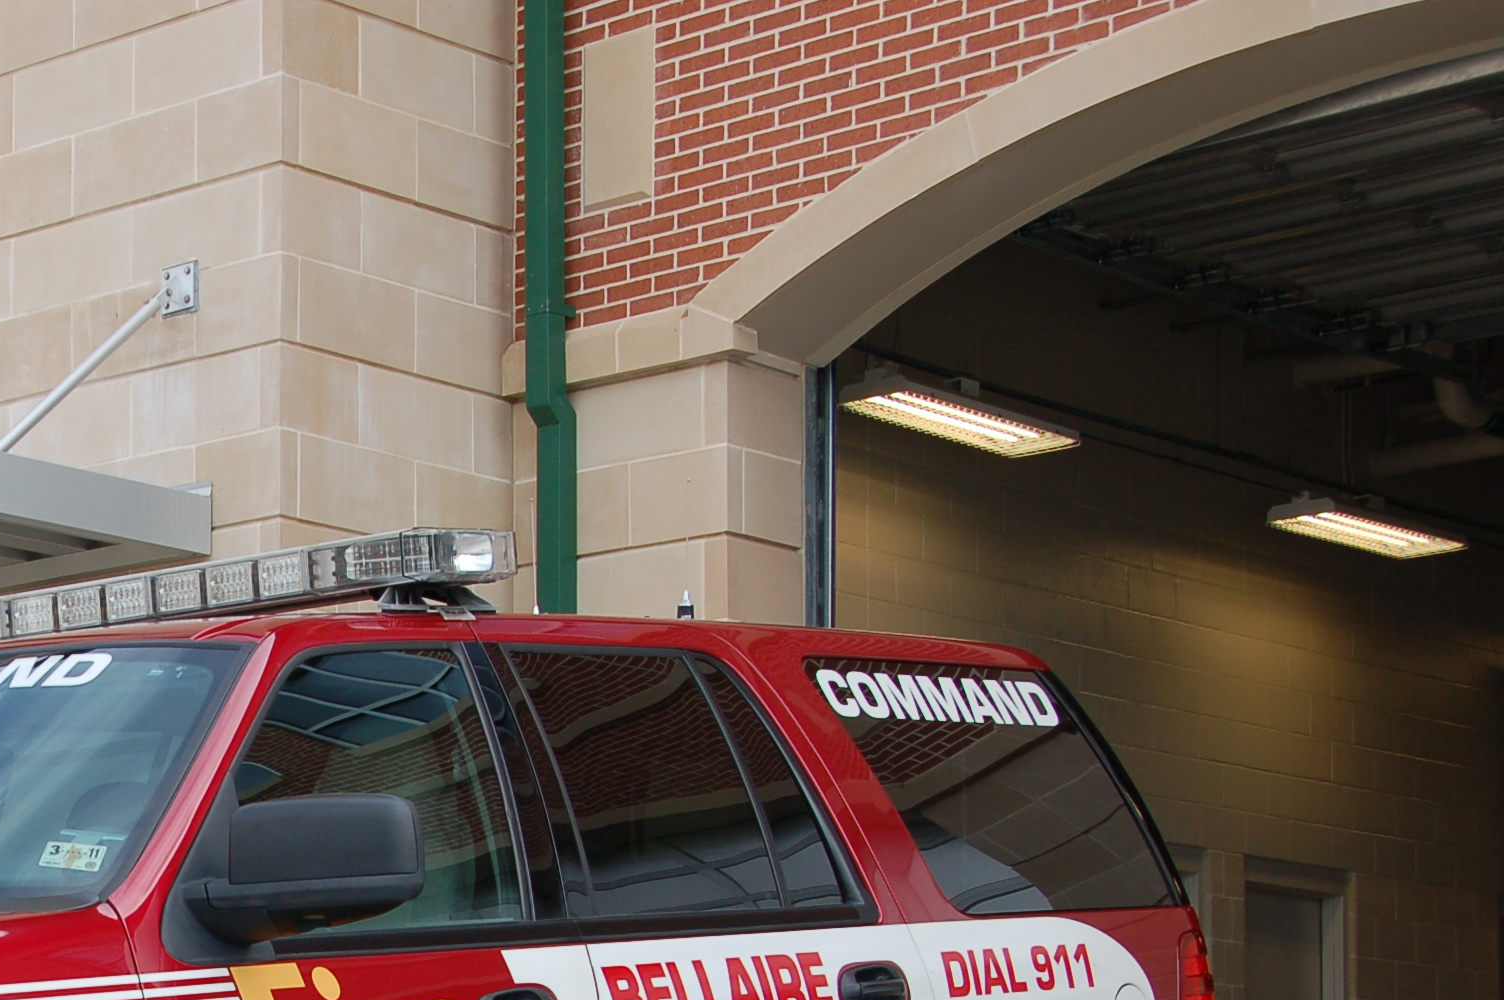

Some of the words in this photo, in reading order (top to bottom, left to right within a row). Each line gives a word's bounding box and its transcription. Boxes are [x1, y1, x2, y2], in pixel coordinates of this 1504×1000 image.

[815, 669, 1060, 727] COMMAND
[49, 845, 61, 855] 3
[88, 847, 101, 859] 11
[940, 947, 1029, 998] DIAL
[1030, 943, 1095, 991] 911
